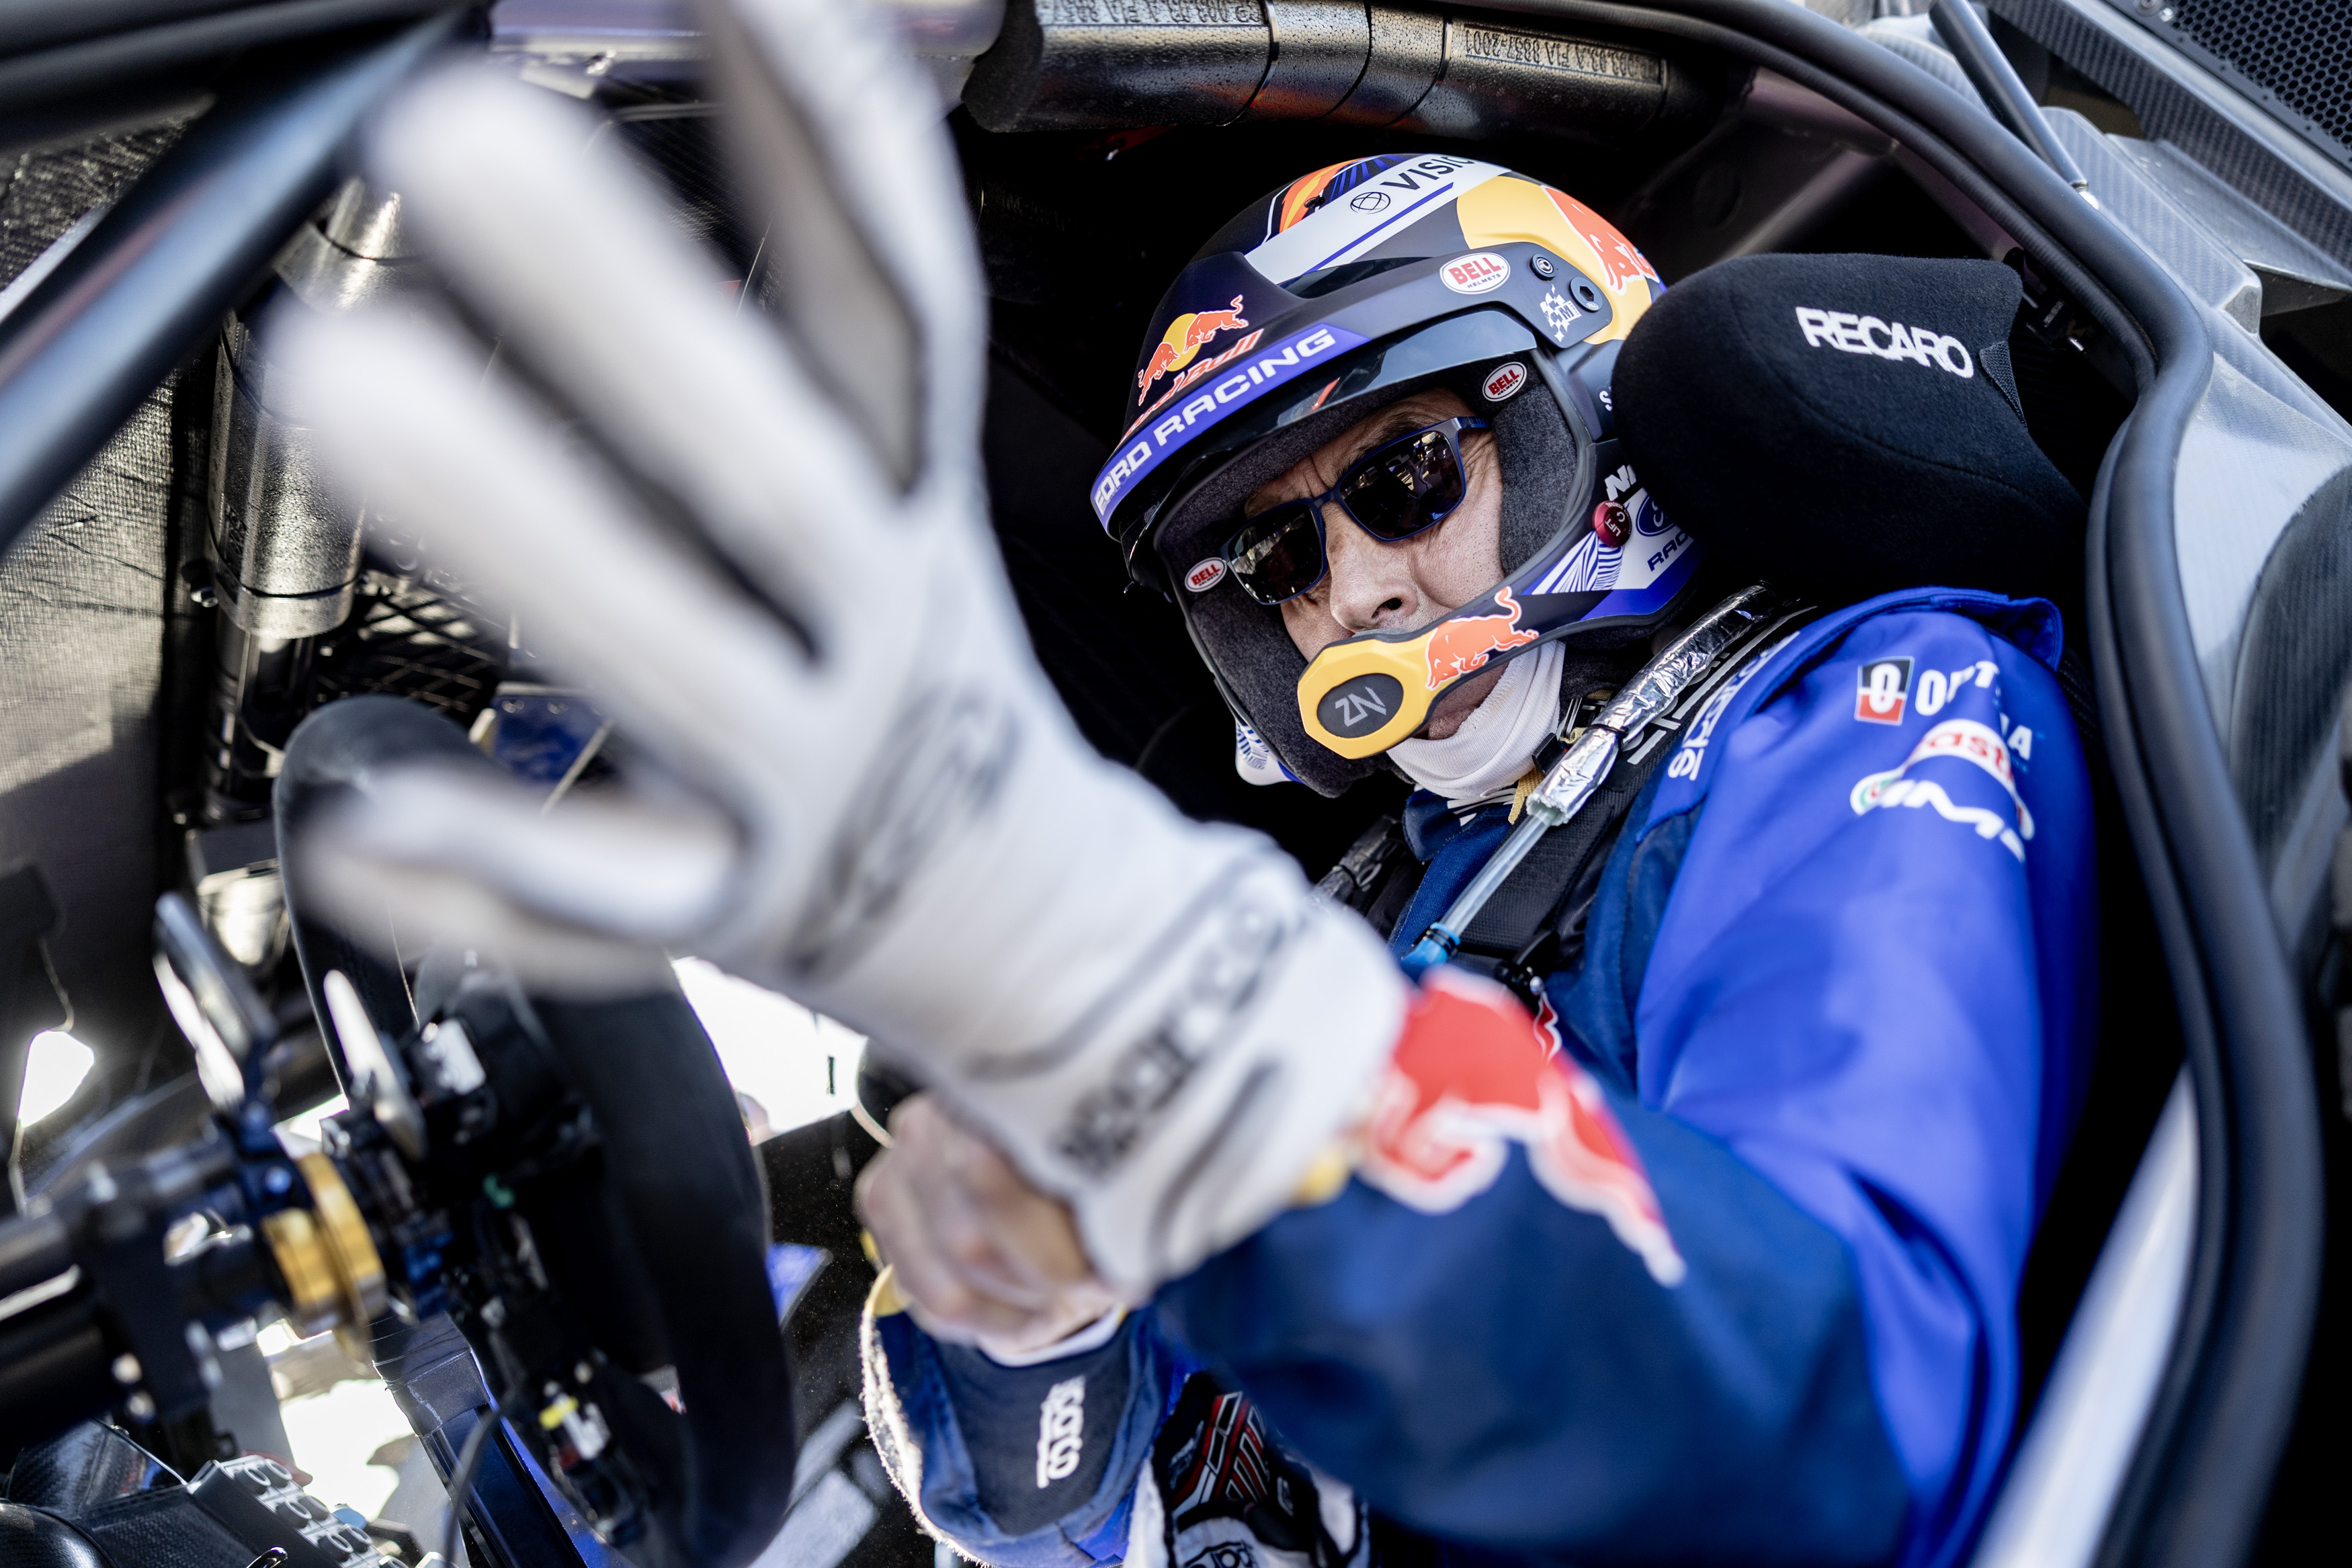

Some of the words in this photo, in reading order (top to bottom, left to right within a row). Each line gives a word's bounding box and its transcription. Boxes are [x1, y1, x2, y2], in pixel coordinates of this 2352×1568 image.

[1546, 41, 1570, 67] FIA
[1448, 257, 1502, 285] BELL
[1467, 273, 1501, 288] HELMETS
[1796, 306, 1974, 378] RECARO
[1175, 328, 1264, 392] Bull
[1488, 369, 1520, 396] BELL
[1497, 380, 1519, 396] HELMETS
[1095, 441, 1152, 516] FORD
[1153, 329, 1336, 446] RACING
[1605, 519, 1621, 537] LIFT
[1191, 564, 1220, 586] BELL
[1335, 687, 1386, 727] ZN
